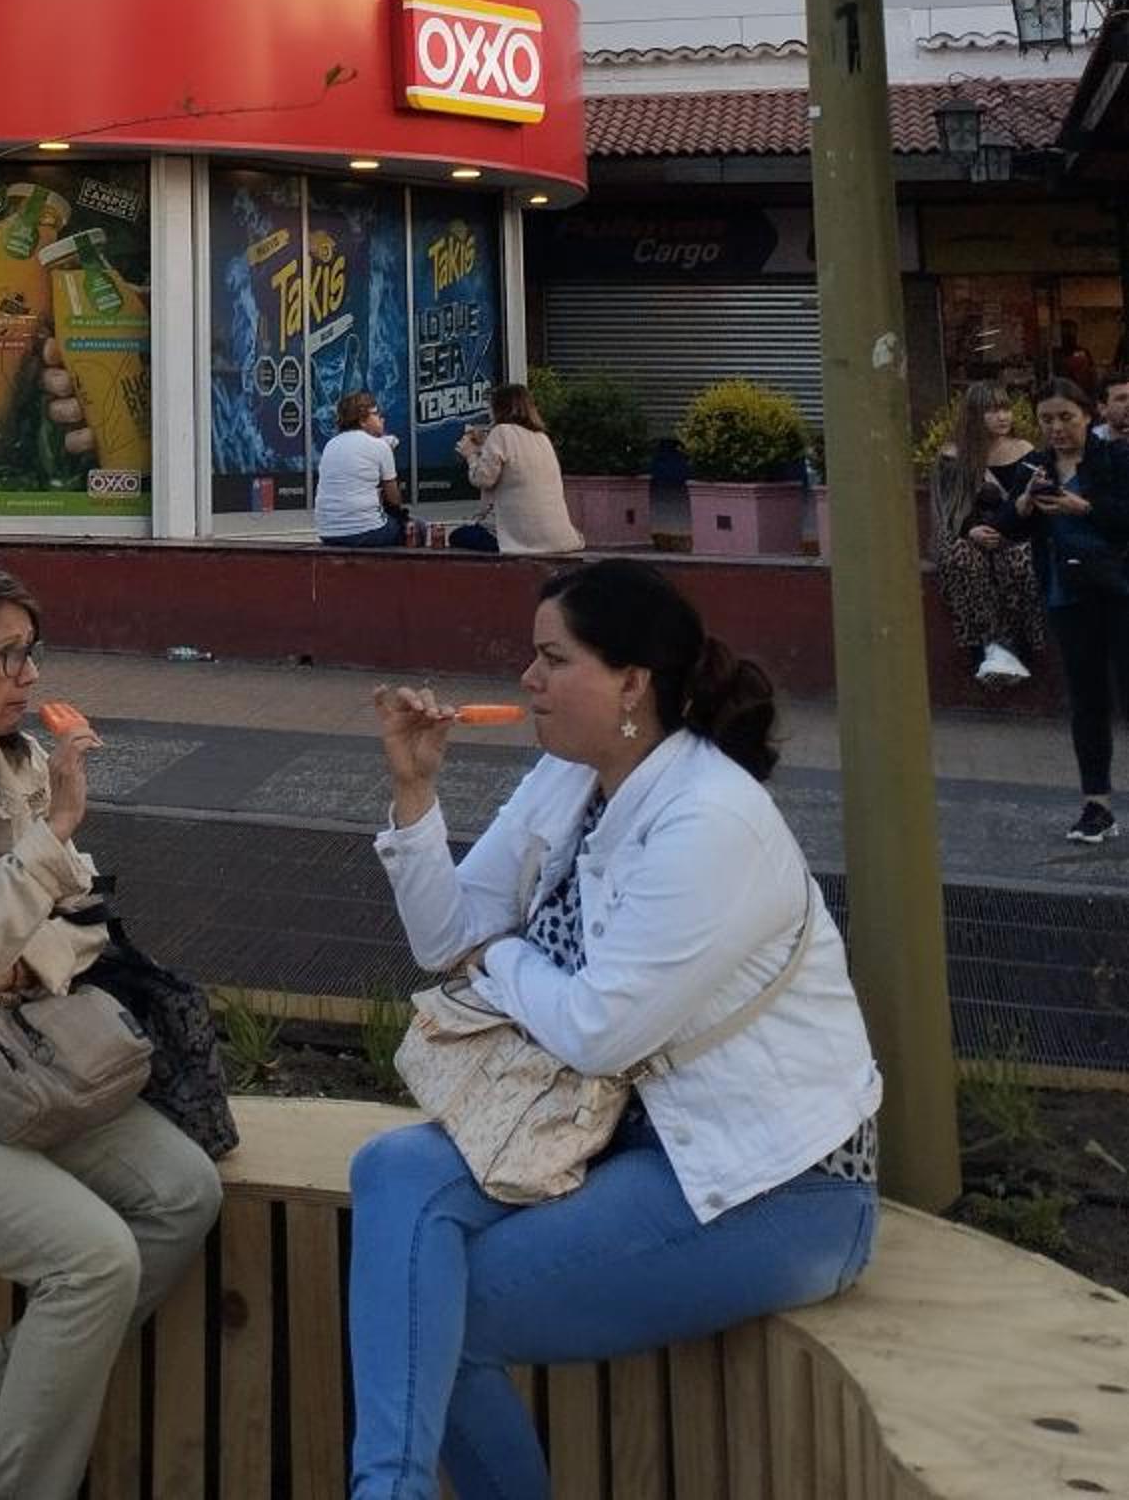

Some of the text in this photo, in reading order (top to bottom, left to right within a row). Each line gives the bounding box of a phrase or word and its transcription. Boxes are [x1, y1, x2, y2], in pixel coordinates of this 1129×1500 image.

[418, 17, 541, 97] OXXO
[632, 236, 721, 269] Cargo
[90, 474, 139, 493] OXXO
